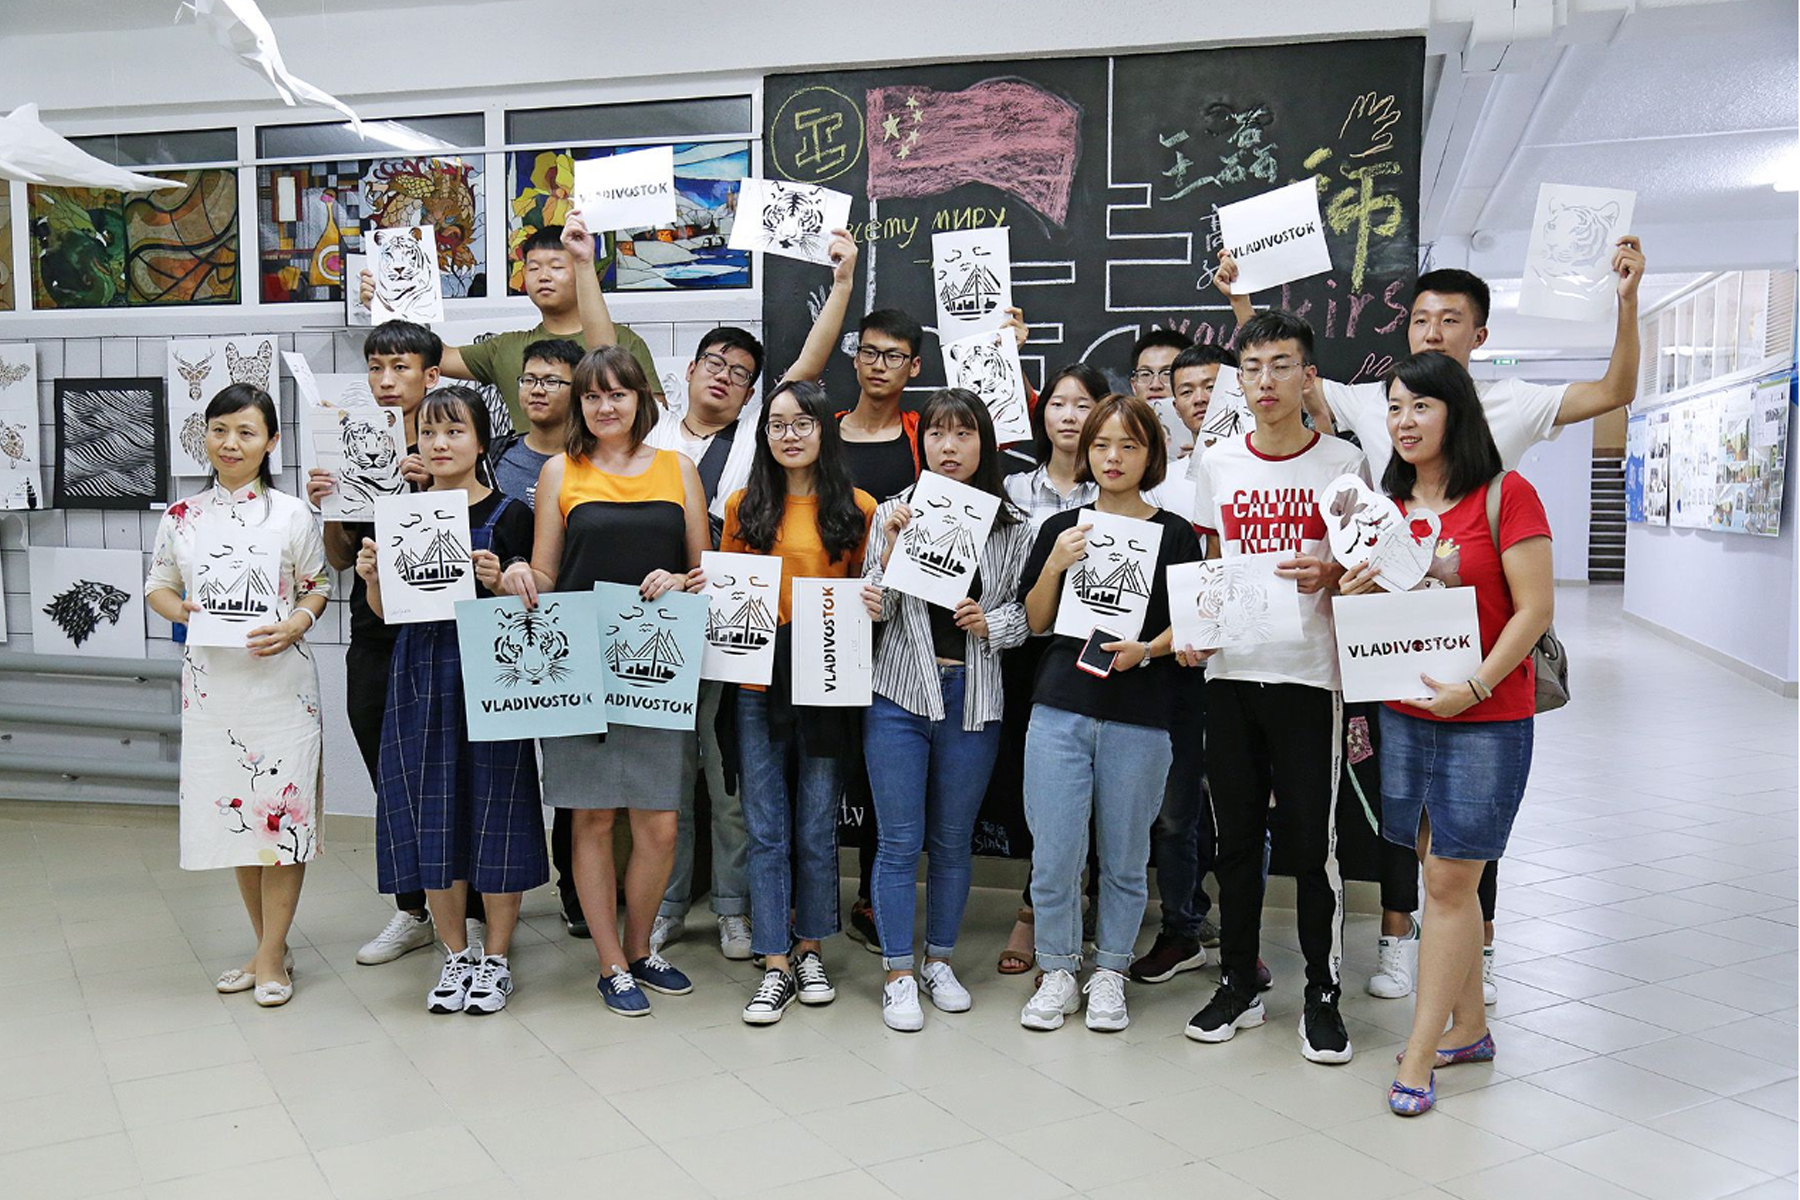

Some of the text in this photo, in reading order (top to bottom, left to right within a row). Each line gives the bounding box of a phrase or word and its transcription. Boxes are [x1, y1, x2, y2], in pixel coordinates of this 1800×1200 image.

[580, 182, 667, 204] VDIVOSTOK
[1230, 221, 1316, 259] VLADIVOSTOK
[1233, 488, 1314, 518] CALVIN
[1240, 522, 1304, 554] KLEIN
[822, 586, 836, 693] VLADIVOSTOK
[1347, 634, 1471, 658] VLADIVOSTOK
[481, 692, 593, 713] VLADIVOSTOK
[604, 693, 694, 715] ADIVOSTOK
